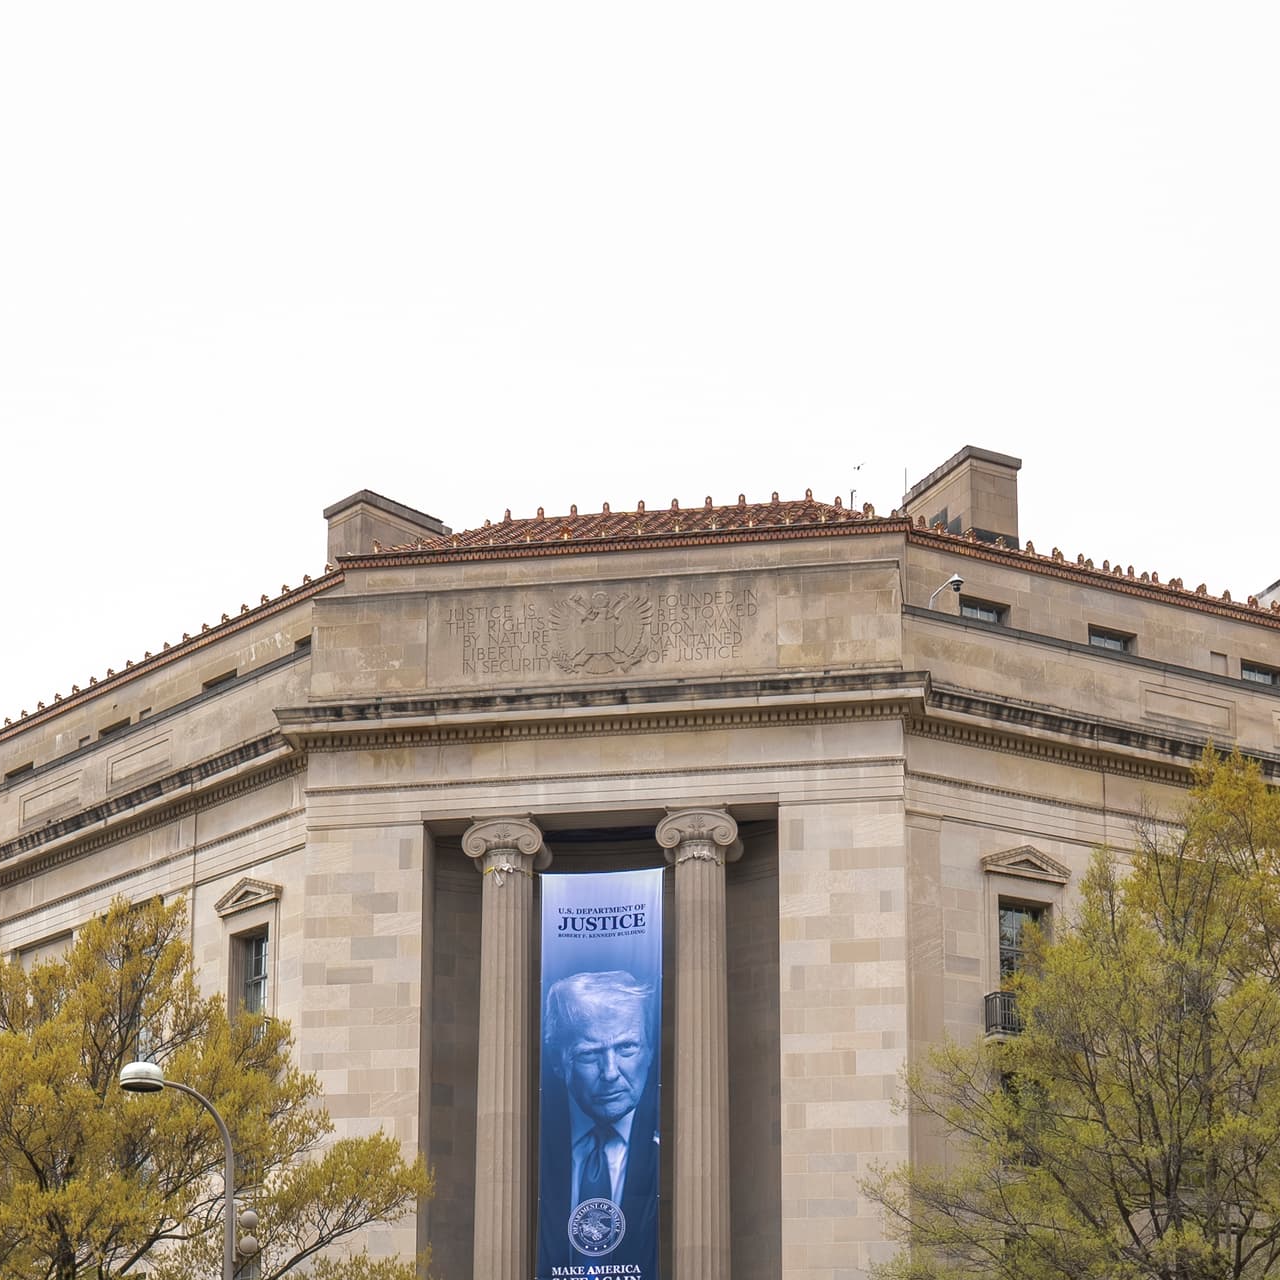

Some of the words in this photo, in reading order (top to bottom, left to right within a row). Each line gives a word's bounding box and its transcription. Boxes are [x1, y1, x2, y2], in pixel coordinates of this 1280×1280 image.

[445, 605, 512, 622] JUSTICE
[523, 603, 536, 617] IS
[658, 590, 735, 608] FOUNDED
[743, 589, 759, 604] IN
[446, 621, 476, 636] THE
[487, 616, 546, 633] RIGHTS
[657, 602, 758, 622] BESTOWED
[463, 633, 480, 648] BY
[488, 630, 551, 647] NATURE
[649, 620, 694, 636] UPON
[463, 645, 526, 661] LIBERTY
[535, 643, 549, 657] IS
[649, 631, 743, 649] MAINTAINED
[463, 660, 476, 675] IN
[482, 657, 553, 673] SECURITY
[647, 649, 669, 664] OF
[558, 907, 575, 915] U.S.
[576, 905, 633, 915] DEPARTMENT
[634, 903, 646, 911] OF
[558, 912, 646, 932] JUSTICE
[617, 929, 646, 937] BUILDING
[551, 1265, 585, 1276] MAKE
[587, 1264, 641, 1276] AMERICA
